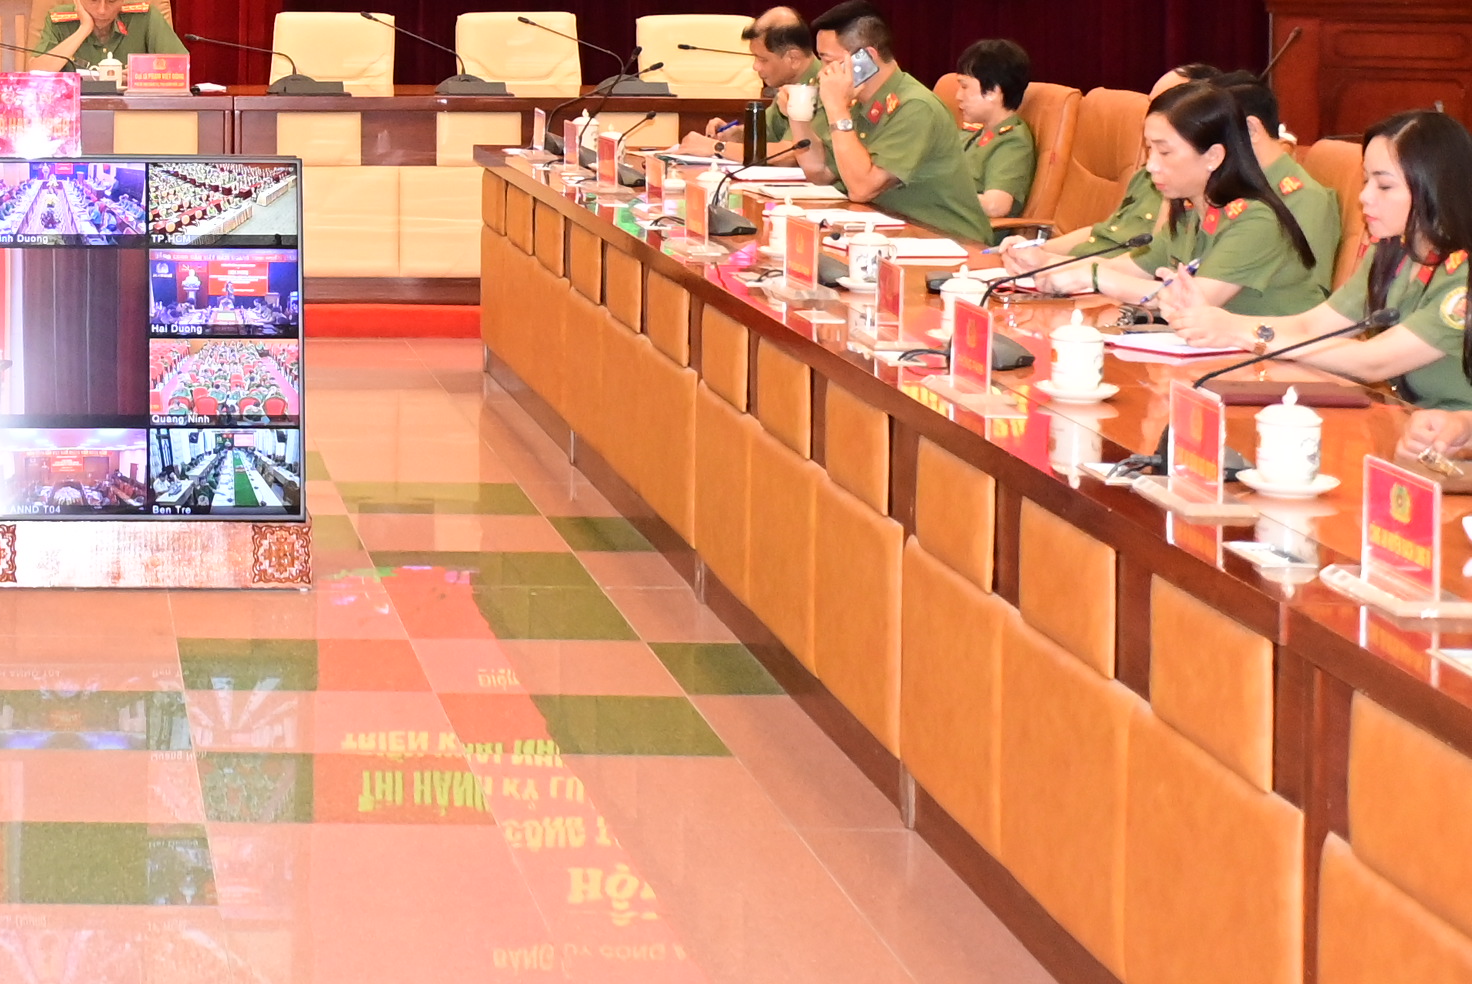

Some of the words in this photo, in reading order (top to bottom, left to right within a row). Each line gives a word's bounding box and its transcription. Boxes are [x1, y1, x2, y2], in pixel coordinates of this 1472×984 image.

[17, 233, 48, 246] Duong
[151, 234, 191, 244] TP.HCM
[151, 323, 168, 334] Hai
[171, 323, 203, 335] Duong
[151, 414, 185, 426] Quang
[188, 414, 210, 424] Ninh
[152, 504, 172, 514] Ben
[174, 504, 192, 514] Tre
